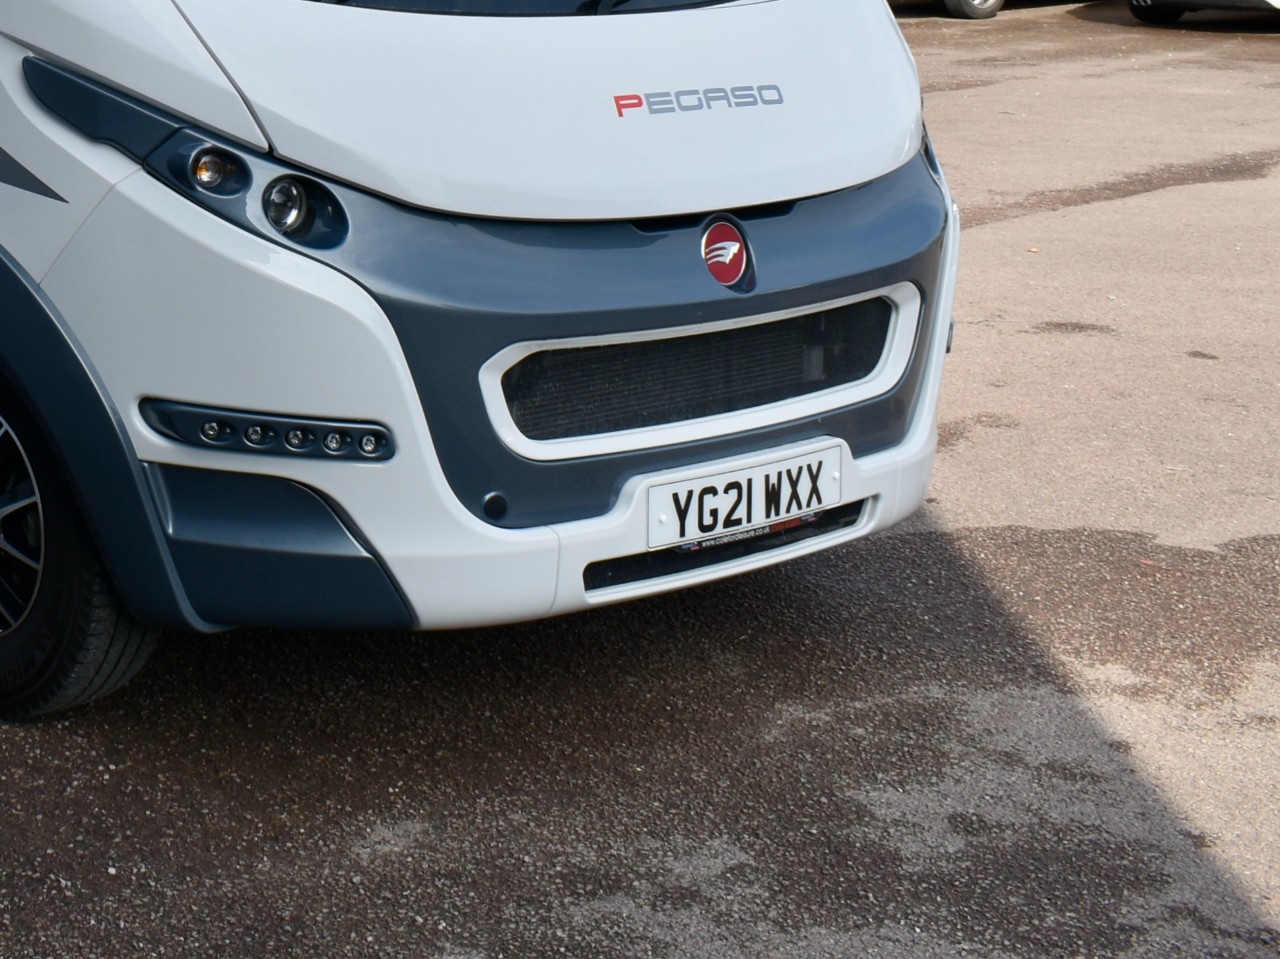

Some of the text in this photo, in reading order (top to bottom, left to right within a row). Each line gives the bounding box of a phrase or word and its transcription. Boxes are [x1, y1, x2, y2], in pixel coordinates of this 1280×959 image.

[613, 83, 785, 118] PEGASO
[671, 460, 823, 538] YG21 WXX
